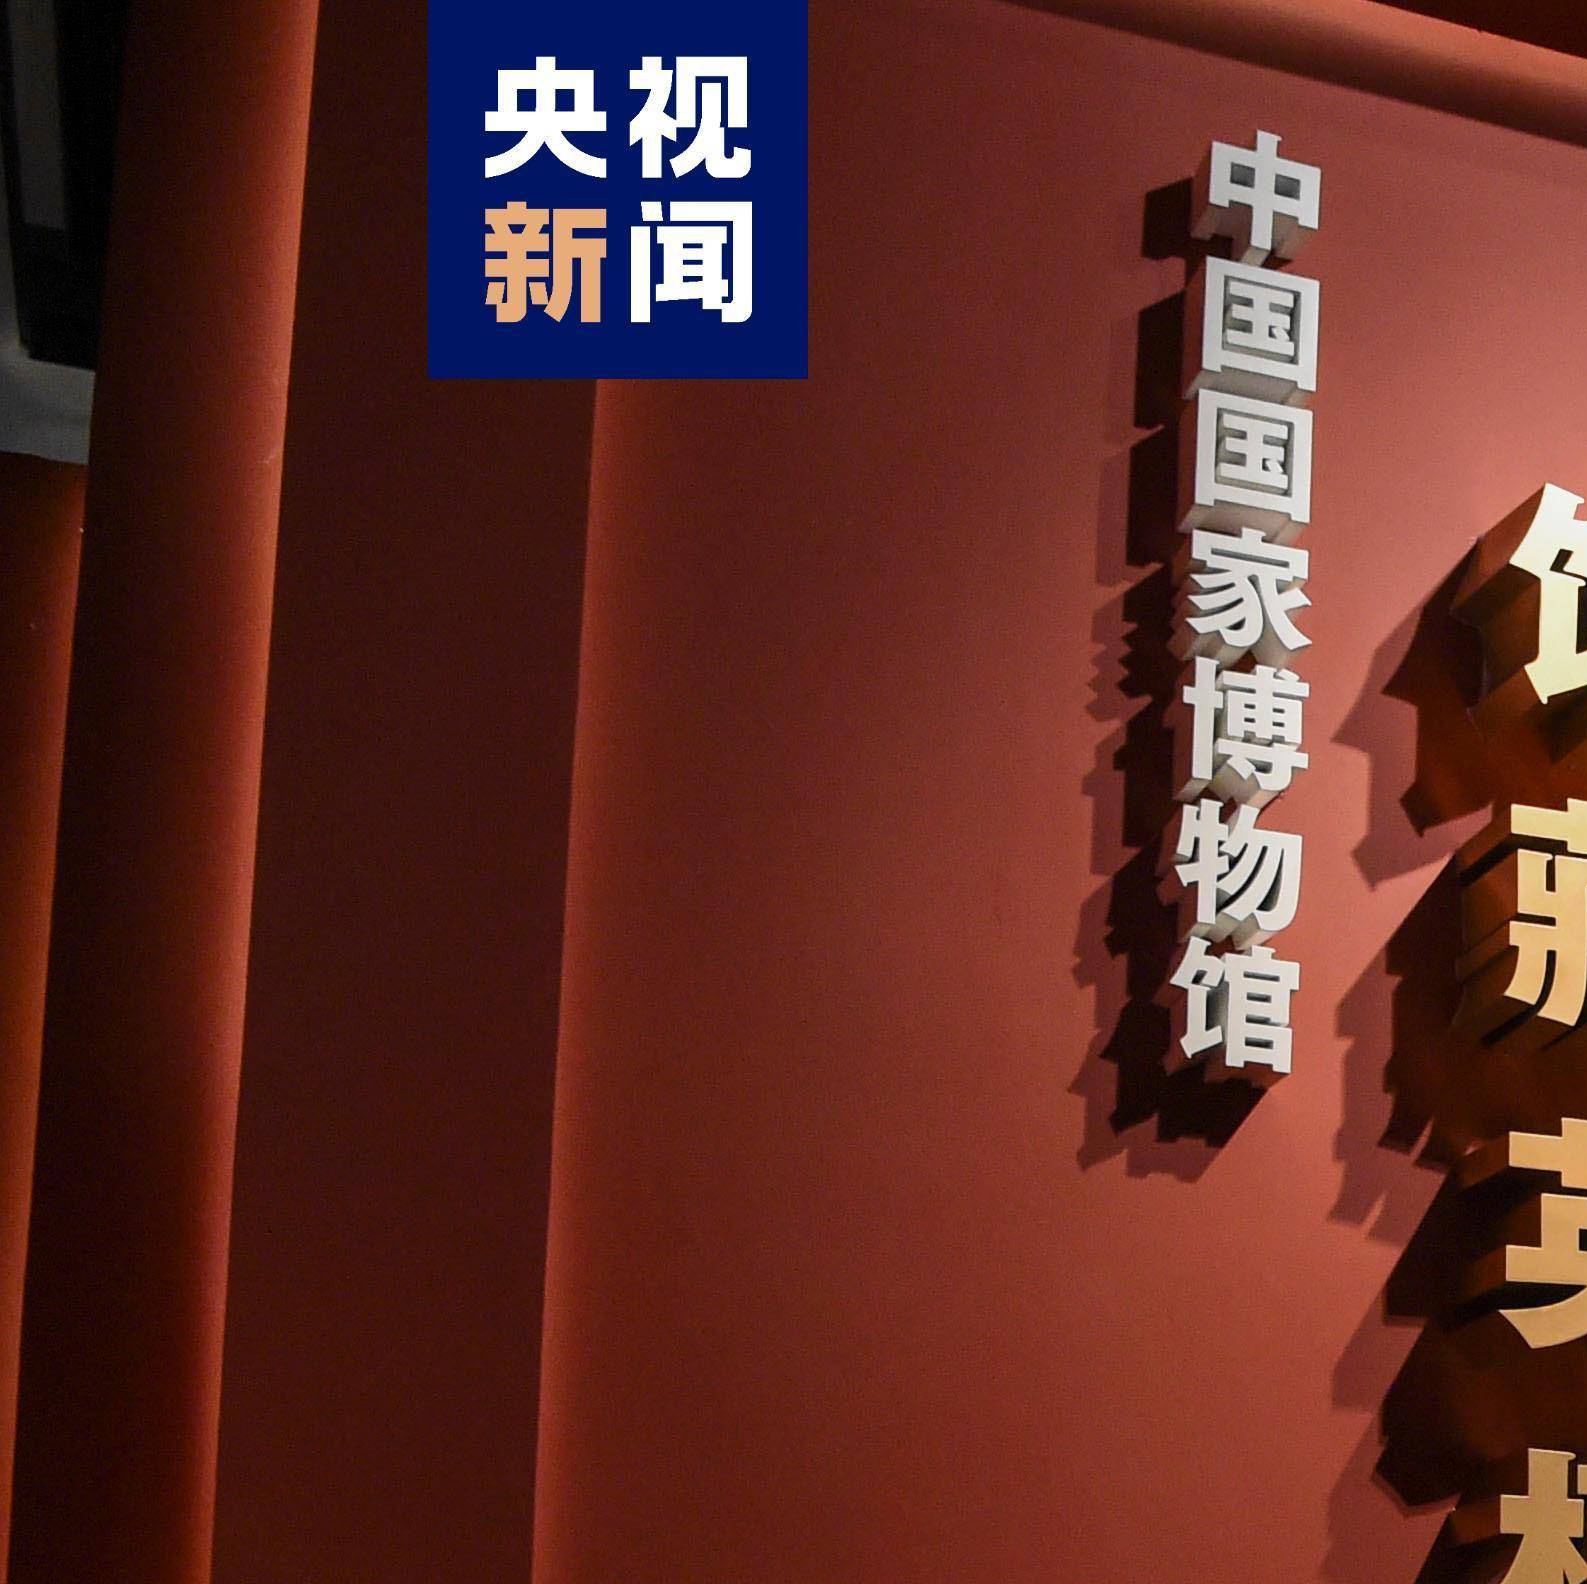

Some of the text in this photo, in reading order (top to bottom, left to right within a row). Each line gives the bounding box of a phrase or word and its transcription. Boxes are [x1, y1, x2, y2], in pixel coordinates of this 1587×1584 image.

[1170, 130, 1322, 1074] 中国国家博物馆
